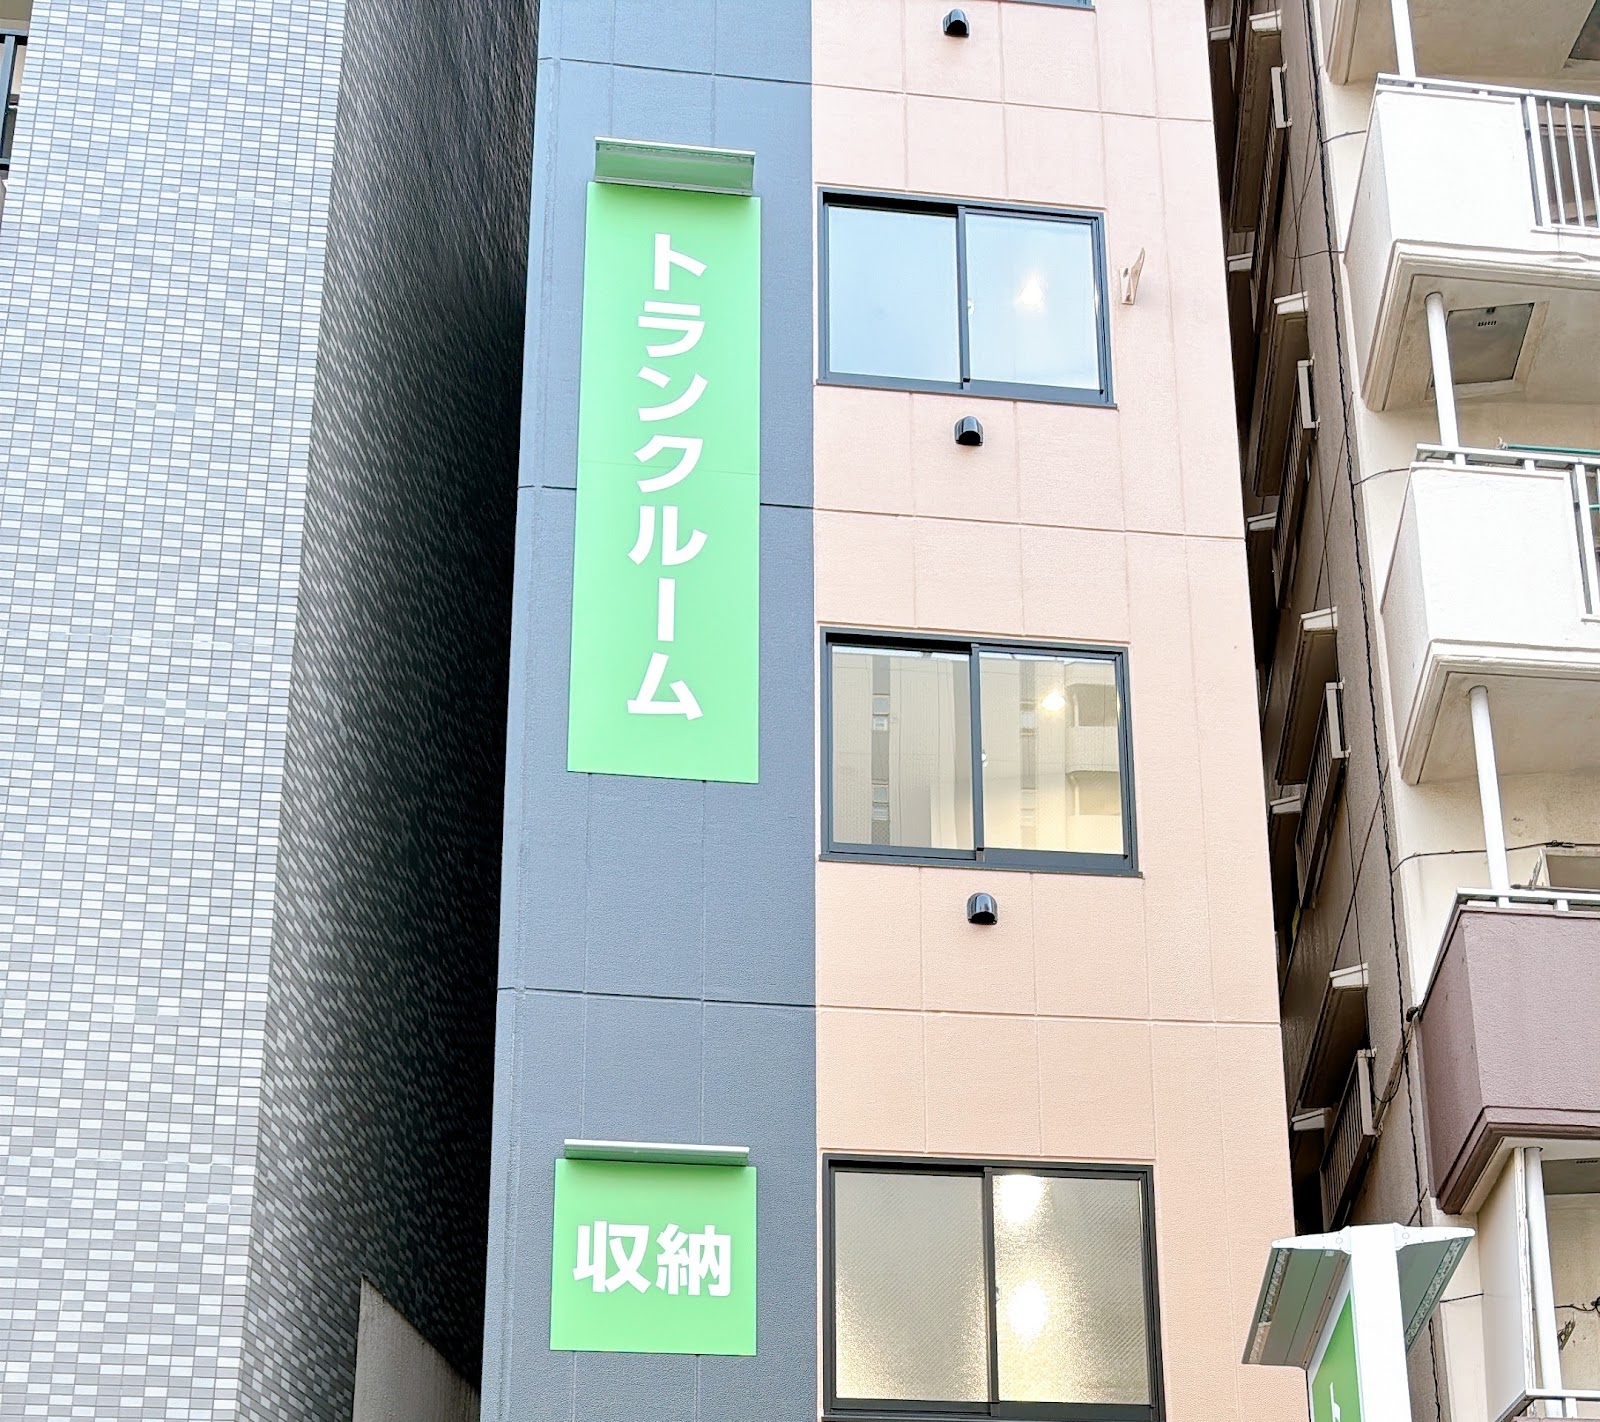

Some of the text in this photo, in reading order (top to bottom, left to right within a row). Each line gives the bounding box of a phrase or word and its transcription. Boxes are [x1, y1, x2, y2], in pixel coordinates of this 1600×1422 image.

[626, 232, 708, 722] トランクルーム
[572, 1220, 732, 1297] 収納
